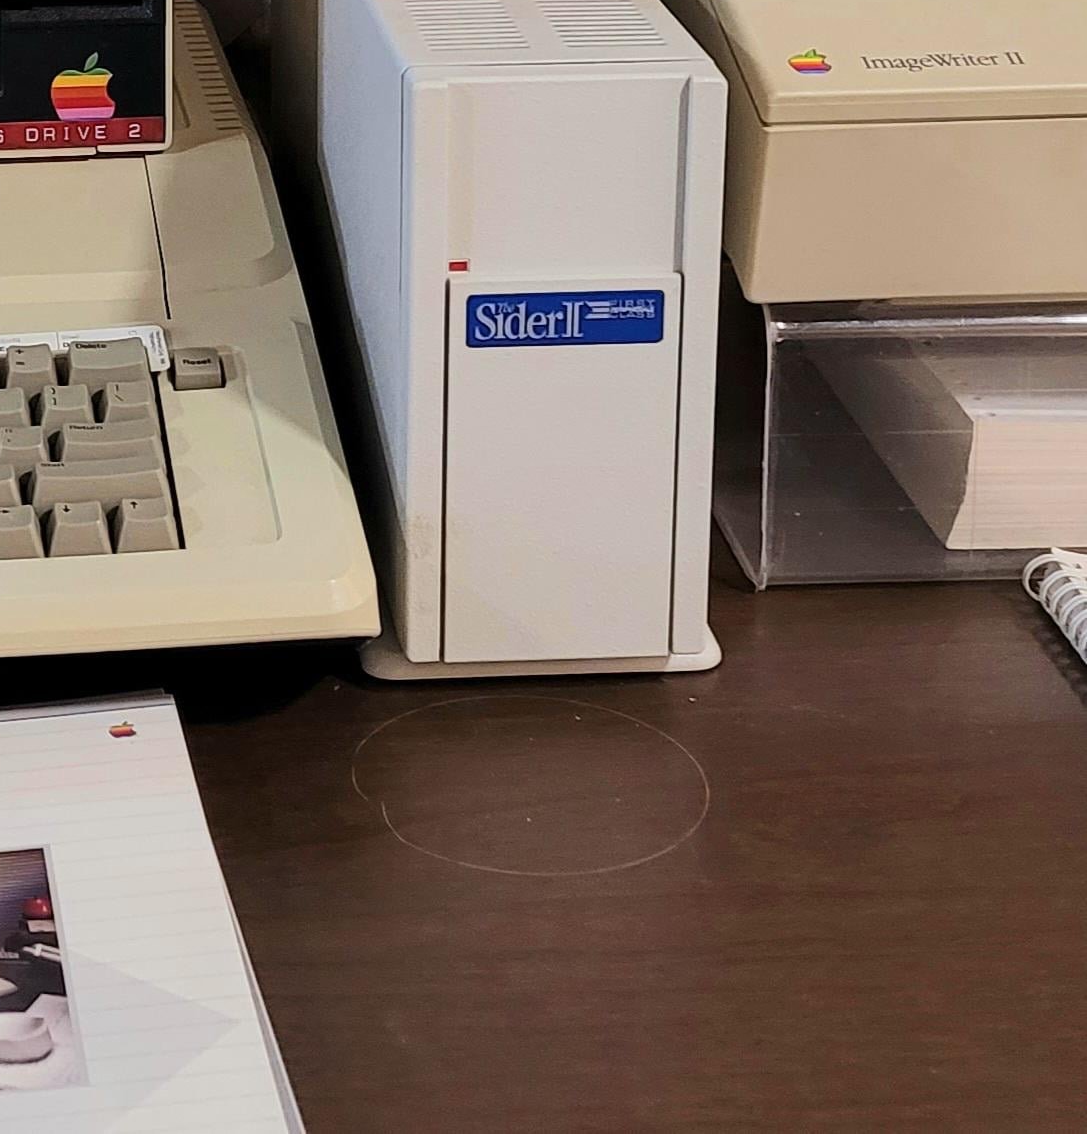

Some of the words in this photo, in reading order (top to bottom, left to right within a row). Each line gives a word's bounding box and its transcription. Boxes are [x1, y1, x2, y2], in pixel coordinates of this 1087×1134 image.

[861, 52, 998, 72] ImageWriter
[1004, 51, 1025, 66] II
[25, 124, 107, 144] DRIVE
[128, 123, 142, 138] 2
[182, 357, 212, 365] Reset
